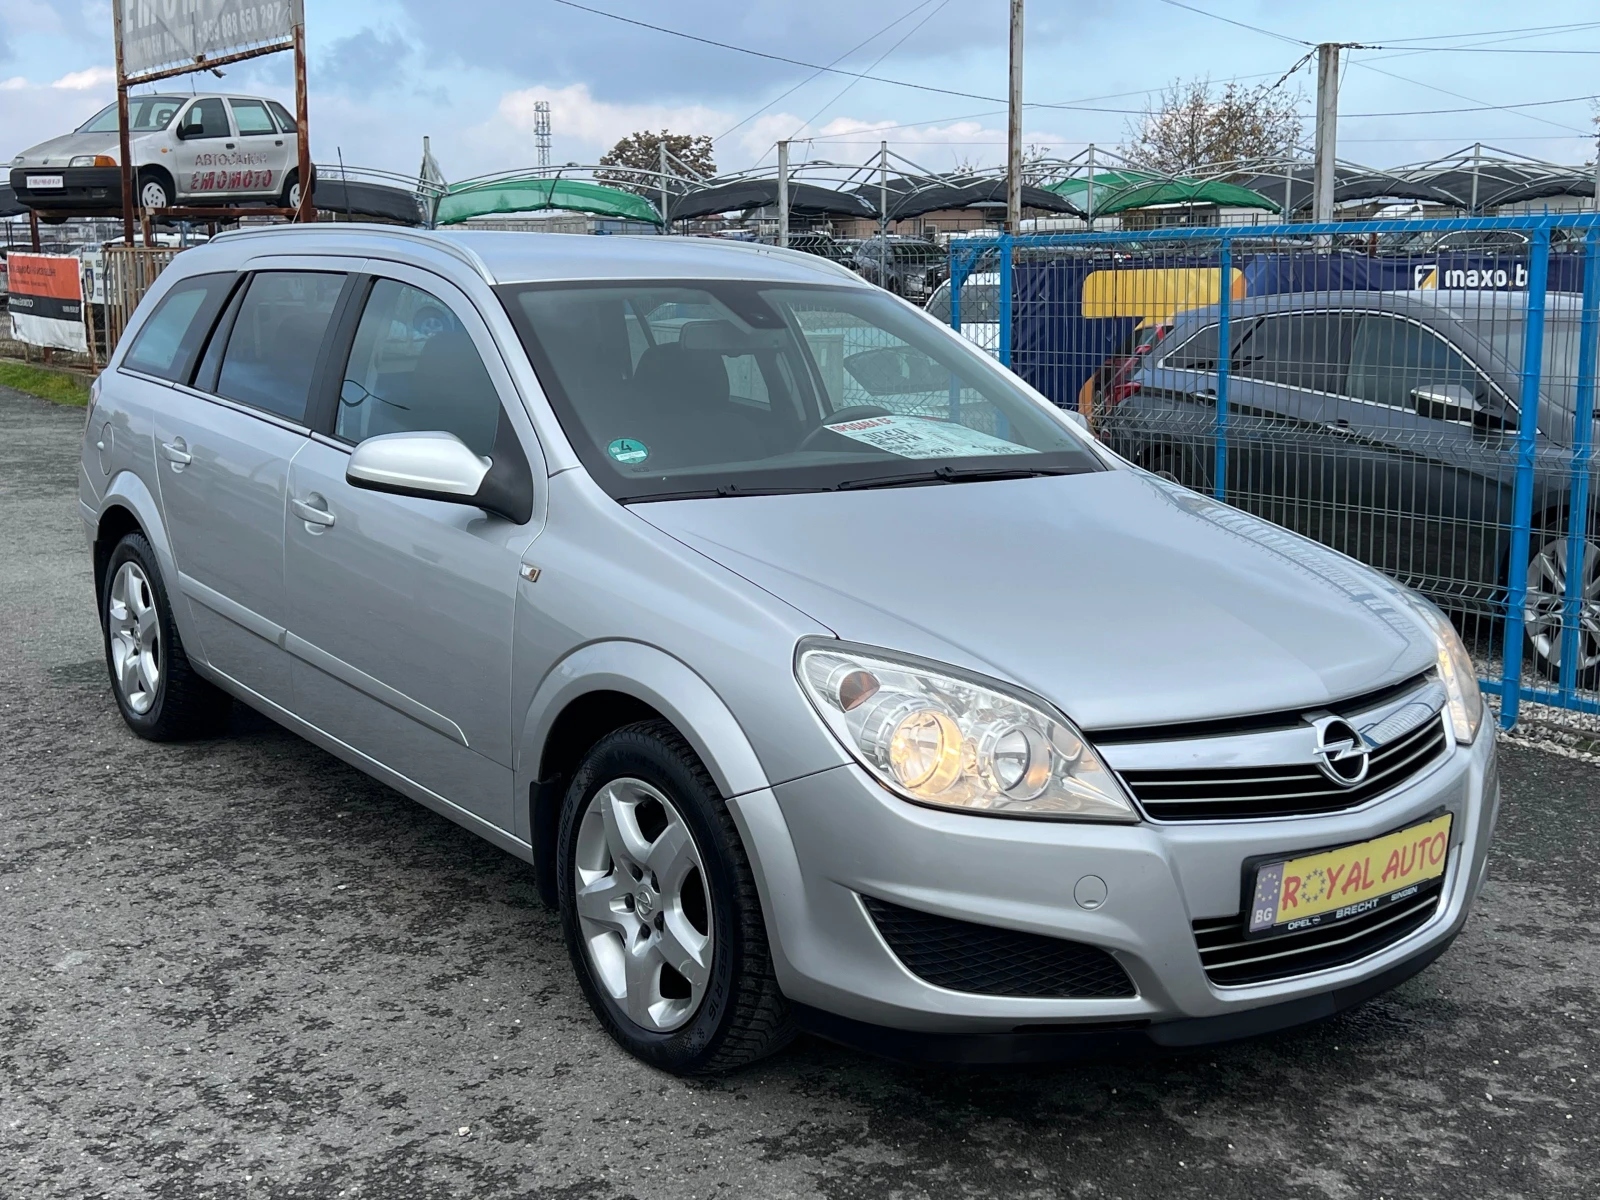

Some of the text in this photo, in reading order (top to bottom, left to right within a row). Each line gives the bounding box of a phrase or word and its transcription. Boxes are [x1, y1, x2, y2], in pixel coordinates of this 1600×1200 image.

[221, 12, 238, 38] 888
[240, 6, 258, 33] 658
[260, 2, 281, 29] 297
[621, 440, 632, 452] 4
[1282, 831, 1446, 911] ROYAL AUTO
[1254, 908, 1273, 924] BG
[1288, 885, 1418, 931] OPEL BRECHT SINGEN
